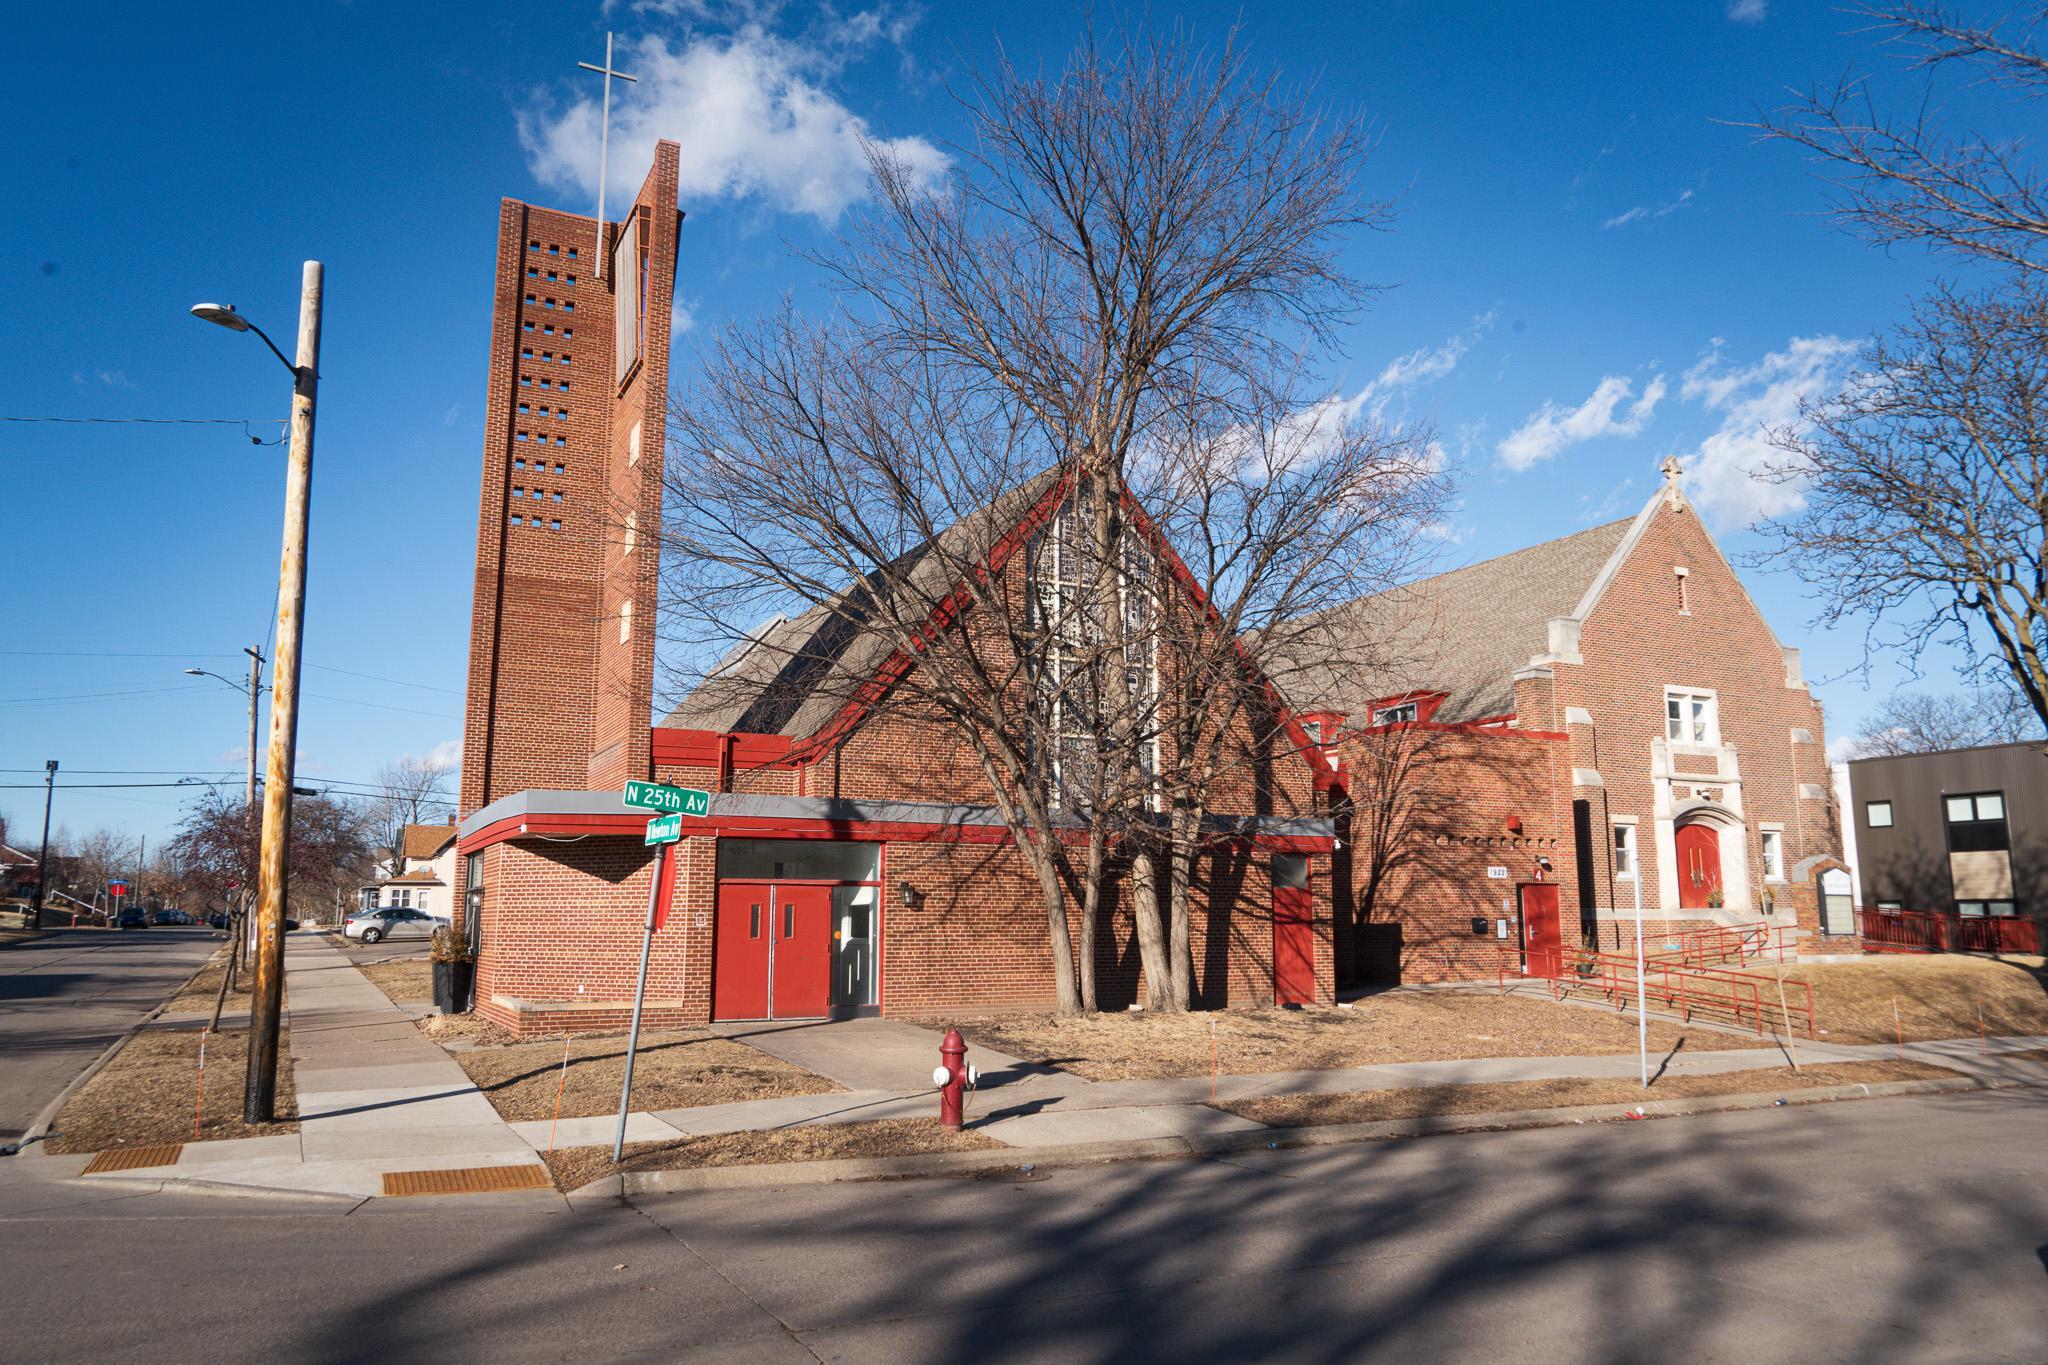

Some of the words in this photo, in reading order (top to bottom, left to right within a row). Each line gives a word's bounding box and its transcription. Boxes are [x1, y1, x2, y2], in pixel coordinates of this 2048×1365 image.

[627, 786, 639, 802] N
[643, 788, 680, 808] 25th
[686, 795, 706, 812] Av
[1536, 870, 1542, 881] 4
